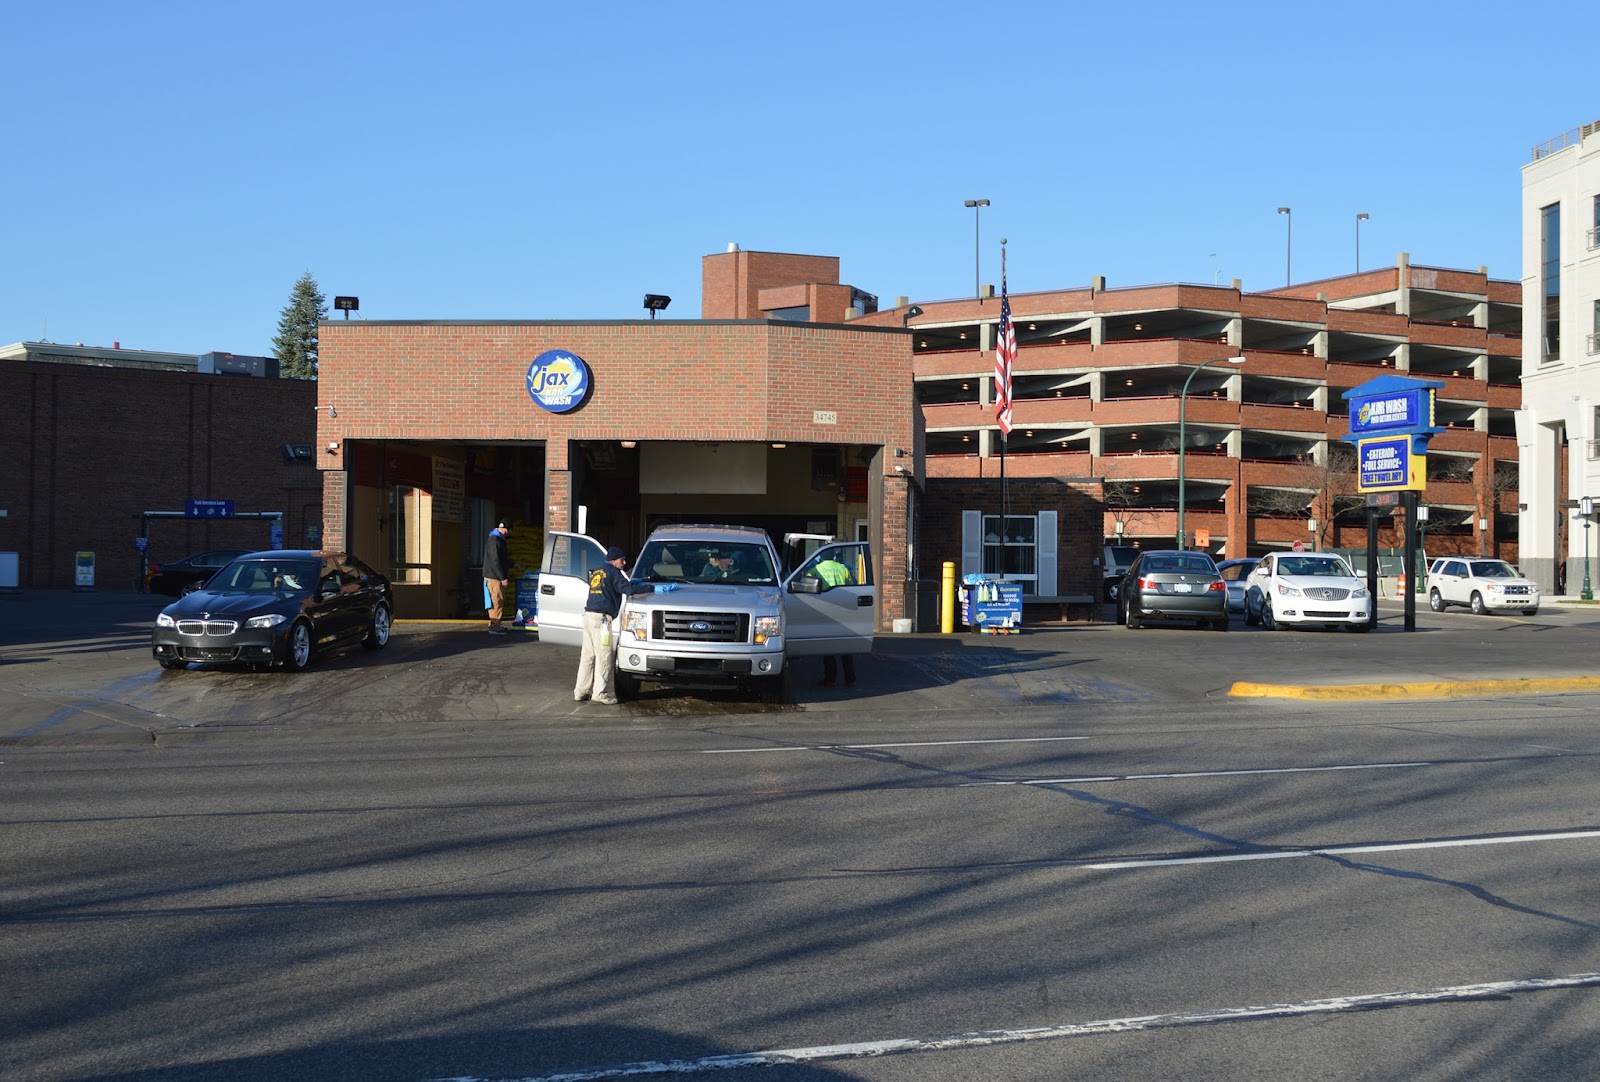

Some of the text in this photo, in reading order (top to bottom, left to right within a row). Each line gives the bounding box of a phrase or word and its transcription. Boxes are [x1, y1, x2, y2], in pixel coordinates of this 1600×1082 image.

[531, 366, 571, 394] jax
[546, 388, 564, 396] KAR
[544, 396, 572, 406] WASH
[1371, 398, 1408, 414] KAR WASH
[816, 414, 835, 422] 34745
[1364, 458, 1400, 471] FULL SERVICE
